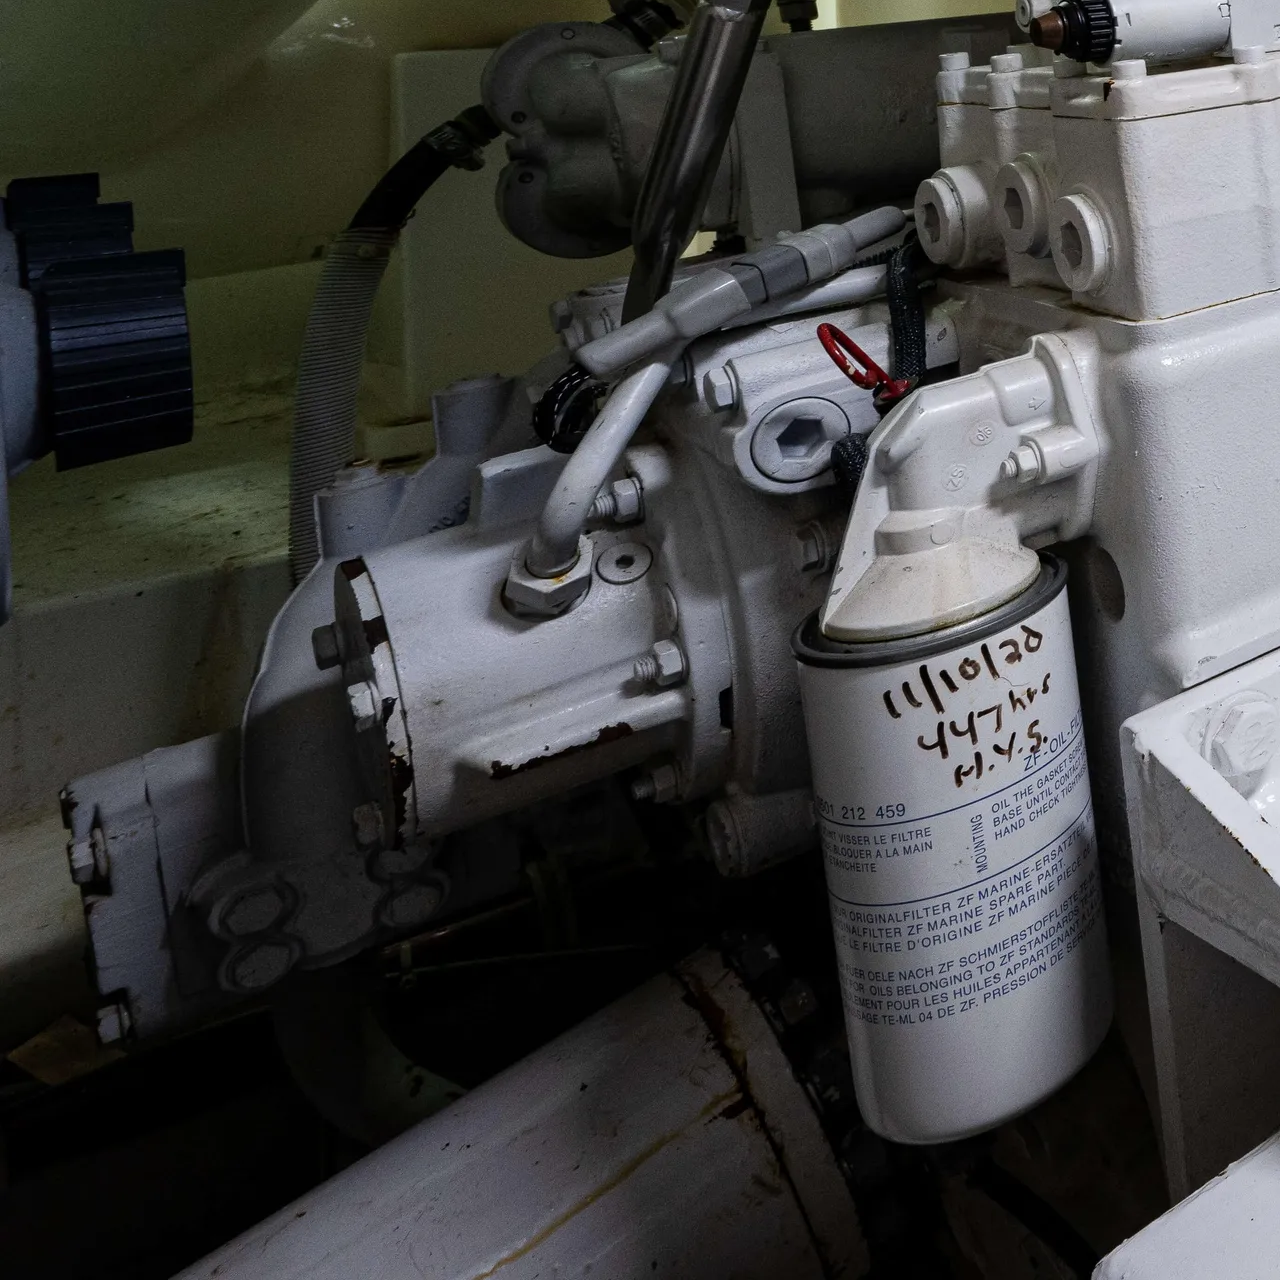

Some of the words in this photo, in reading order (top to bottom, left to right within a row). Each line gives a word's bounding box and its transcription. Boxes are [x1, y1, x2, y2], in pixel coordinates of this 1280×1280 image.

[882, 624, 1043, 719] 11/10/20
[917, 704, 1002, 760] 447
[841, 806, 866, 820] 212
[875, 803, 906, 819] 459
[991, 798, 1011, 814] OIL
[1013, 784, 1034, 802] THE
[1036, 759, 1068, 790] GASKET
[993, 805, 1022, 828] BASE
[1026, 786, 1053, 810] UNTIL
[1054, 760, 1082, 790] CONTACT
[994, 819, 1026, 841] HAND
[1029, 795, 1060, 822] CHECK
[840, 835, 870, 846] VISSER
[874, 835, 888, 845] LE
[891, 826, 932, 843] FILTRE
[876, 849, 882, 859] A
[886, 847, 900, 858] LA
[903, 840, 933, 857] MAIN
[970, 813, 988, 874] MOUNTING
[849, 902, 951, 924] ORIGINALFILTER
[957, 893, 974, 909] ZF
[850, 939, 860, 951] LE
[863, 942, 902, 953] FILTRE
[907, 919, 983, 951] D'ORIGINE
[988, 910, 1006, 927] ZF
[1008, 882, 1055, 917] MARINE
[1056, 856, 1082, 887] PIECE
[907, 924, 924, 936] ZF
[928, 905, 983, 932] MARINE
[989, 881, 1033, 911] SPARE
[1037, 859, 1066, 885] PART.
[868, 971, 895, 982] OELE
[899, 966, 934, 981] NACH
[938, 960, 954, 974] ZF
[959, 893, 1078, 969] SCHMIERSTOFFLISTE
[869, 984, 893, 997] OILS
[897, 970, 973, 996] BELONGING
[977, 960, 995, 976] TO
[1000, 950, 1015, 964] ZF
[1019, 908, 1079, 956] STANDARDS
[886, 998, 920, 1011] POUR
[924, 992, 949, 1007] LES
[953, 972, 1001, 1000] HUILES
[1005, 920, 1081, 979] APPARTENANT
[882, 1013, 916, 1026] TE-ML
[918, 1012, 933, 1022] 04
[937, 1005, 955, 1019] DE
[960, 997, 979, 1013] ZF.
[983, 963, 1047, 1003] PRESSION
[1050, 951, 1065, 967] DE
